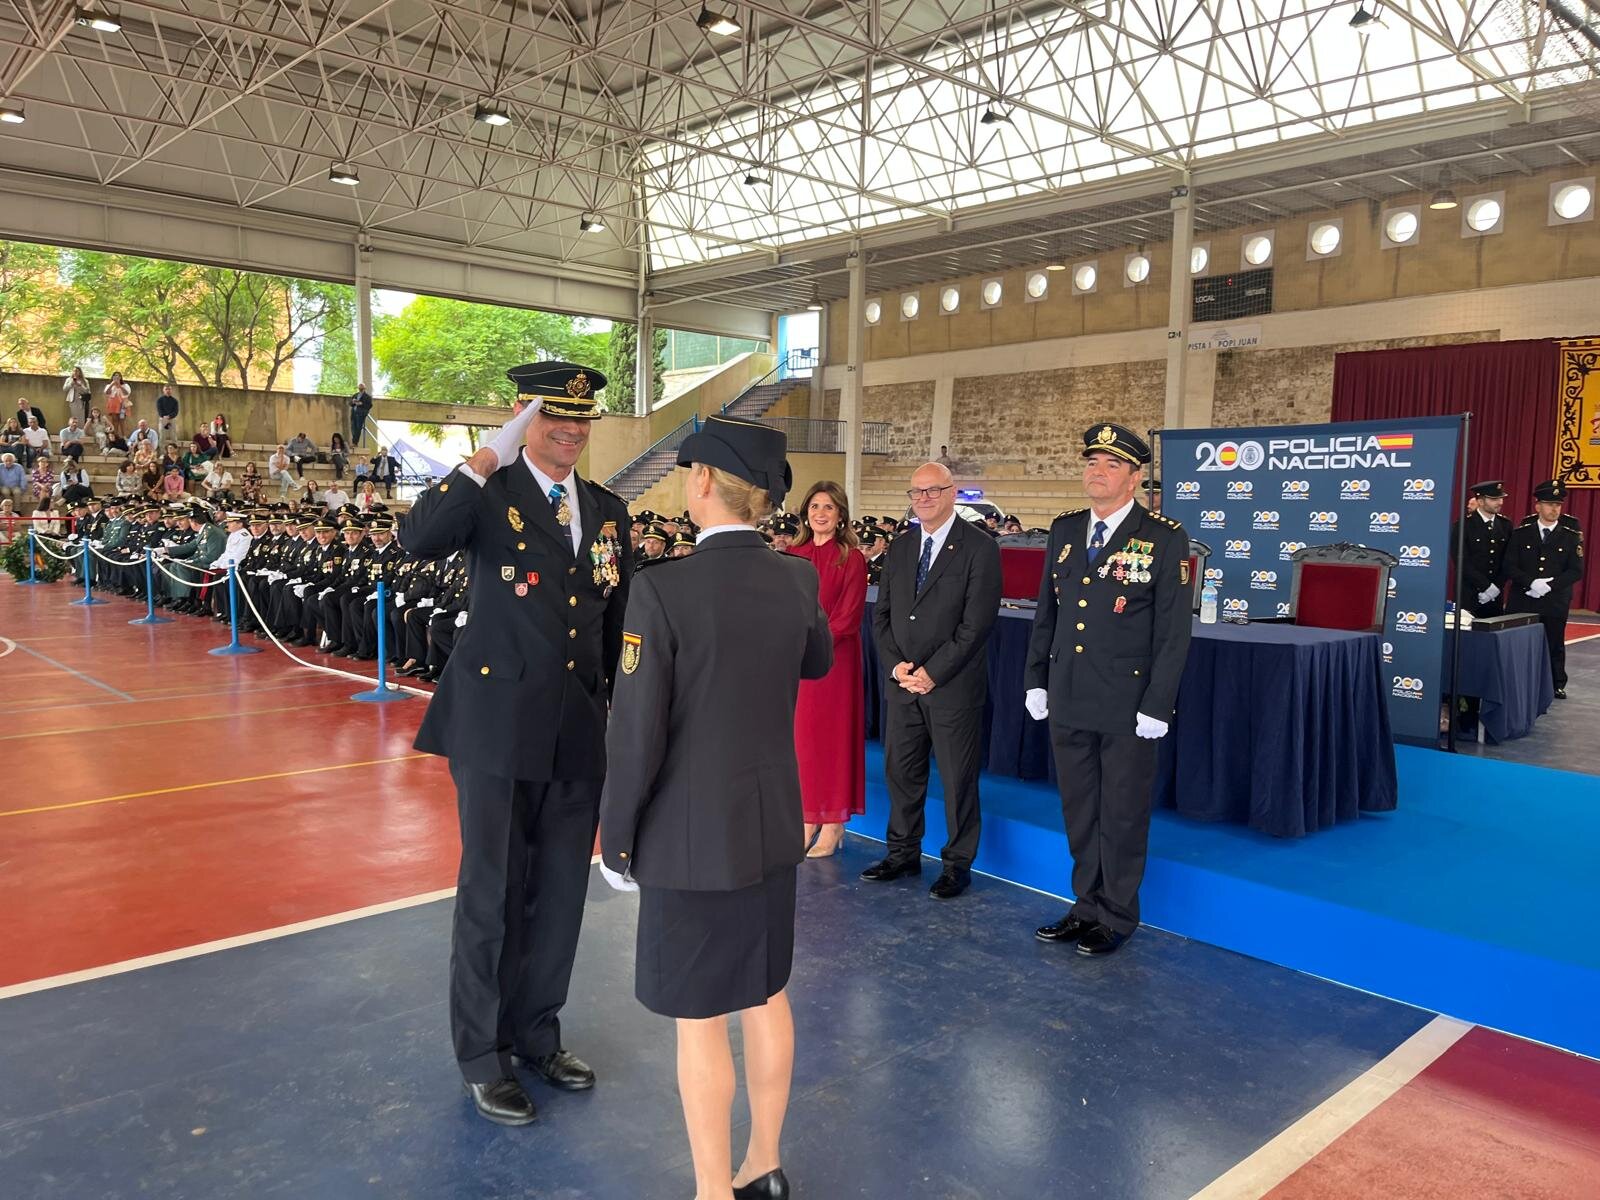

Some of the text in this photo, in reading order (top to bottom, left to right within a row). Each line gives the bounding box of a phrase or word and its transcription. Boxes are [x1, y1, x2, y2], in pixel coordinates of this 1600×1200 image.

[1195, 294, 1215, 303] LOCAL
[1187, 342, 1206, 351] PISTA
[1238, 337, 1258, 346] JUAN
[1269, 435, 1382, 455] POLICIA
[1195, 440, 1265, 472] 200
[1268, 452, 1412, 471] NACIONAL
[1176, 481, 1200, 493] 200
[1227, 481, 1253, 493] 200
[1282, 480, 1310, 493] 200
[1341, 479, 1371, 492] 200
[1403, 478, 1435, 492] 200
[1200, 510, 1226, 522] 200
[1253, 510, 1280, 523] 200
[1309, 511, 1338, 524] 200
[1369, 511, 1400, 525] 200
[1225, 539, 1251, 552] 200
[1399, 545, 1431, 559] 200
[1251, 570, 1277, 582] 200
[1223, 598, 1249, 611] 200
[1396, 611, 1428, 625] 200
[1393, 675, 1423, 691] 200
